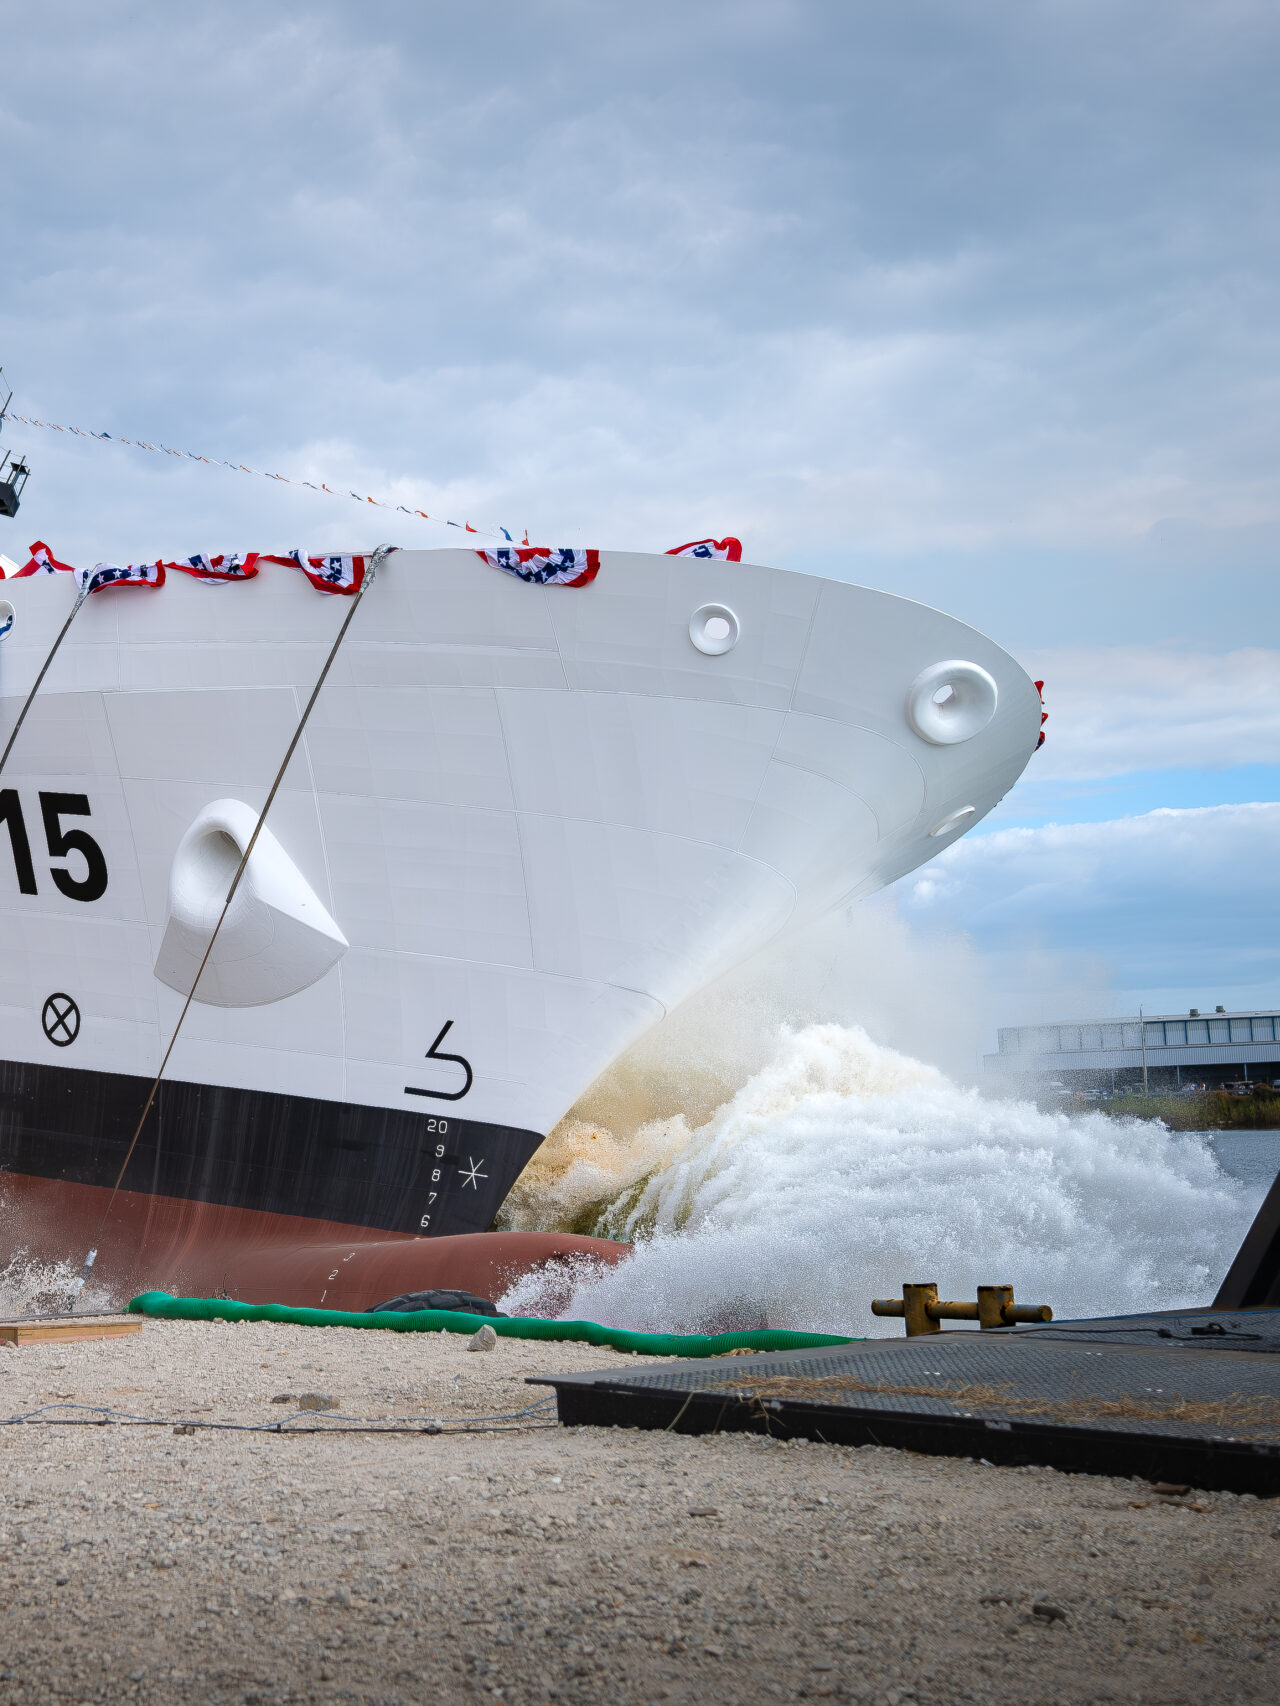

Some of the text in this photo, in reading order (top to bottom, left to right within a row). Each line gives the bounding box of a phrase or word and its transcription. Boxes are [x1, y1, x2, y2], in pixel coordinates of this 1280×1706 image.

[427, 1119, 448, 1134] 20
[435, 1145, 445, 1157] 9
[431, 1169, 440, 1182] 8
[428, 1192, 437, 1205] 7
[420, 1215, 431, 1227] 6
[328, 1269, 339, 1280] 2
[320, 1289, 327, 1302] 1
